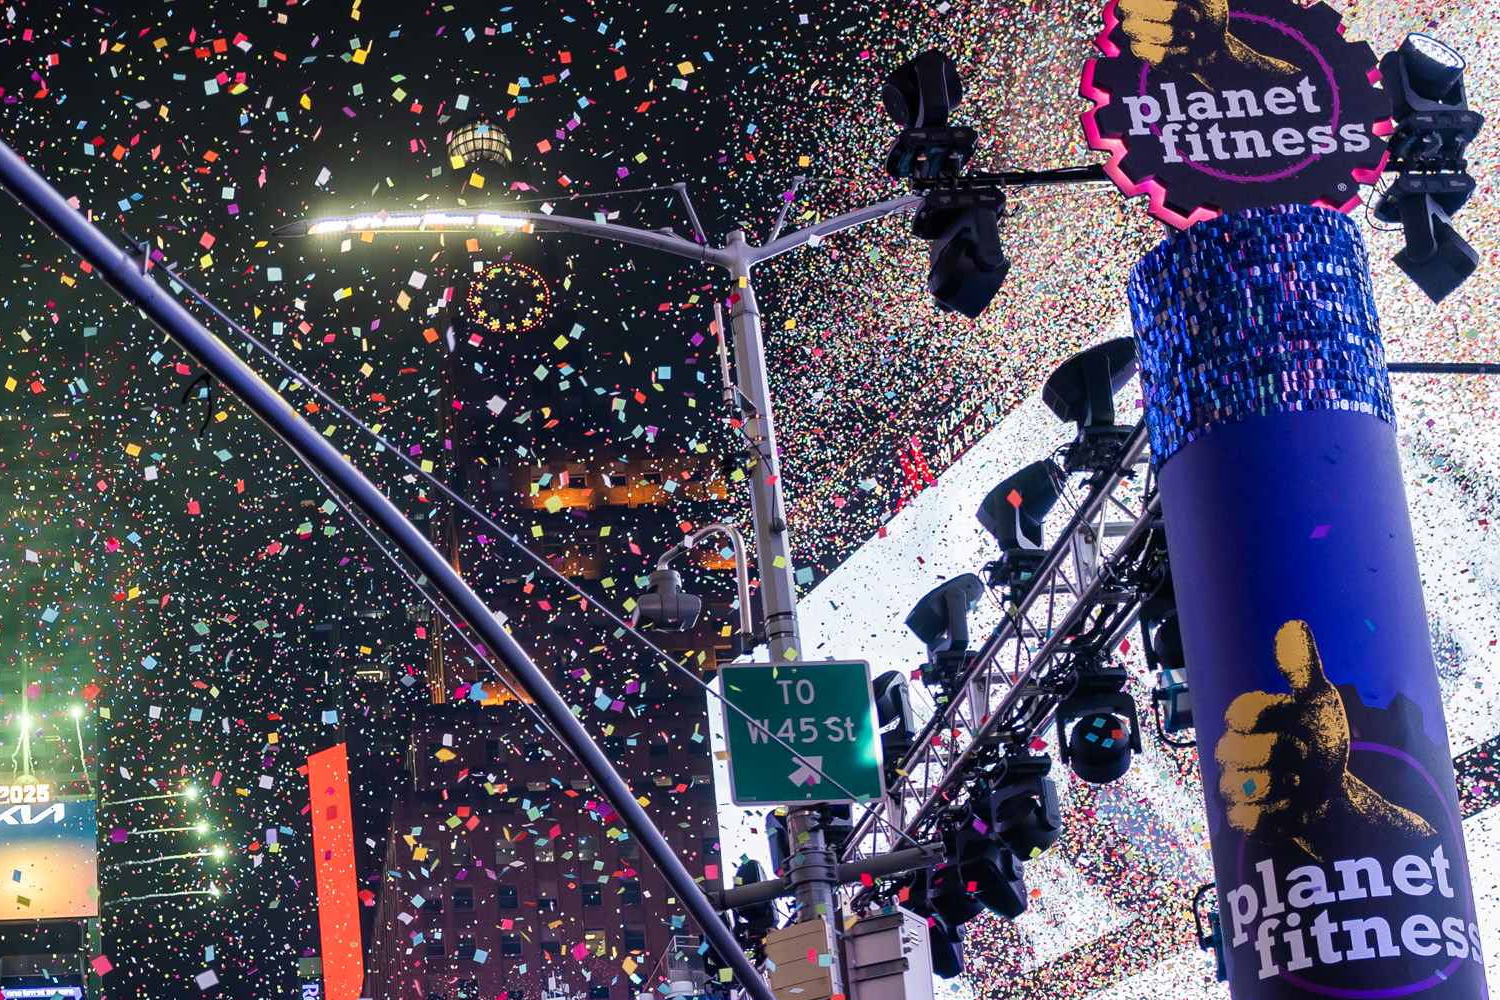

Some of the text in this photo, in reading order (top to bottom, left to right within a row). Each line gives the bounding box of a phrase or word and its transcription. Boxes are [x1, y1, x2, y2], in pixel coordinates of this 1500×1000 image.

[1121, 75, 1321, 137] planet
[1157, 122, 1371, 164] fitness
[776, 679, 816, 705] TO
[746, 716, 856, 744] W 45 St
[1226, 844, 1455, 948] planet
[1253, 908, 1483, 981] fitness
